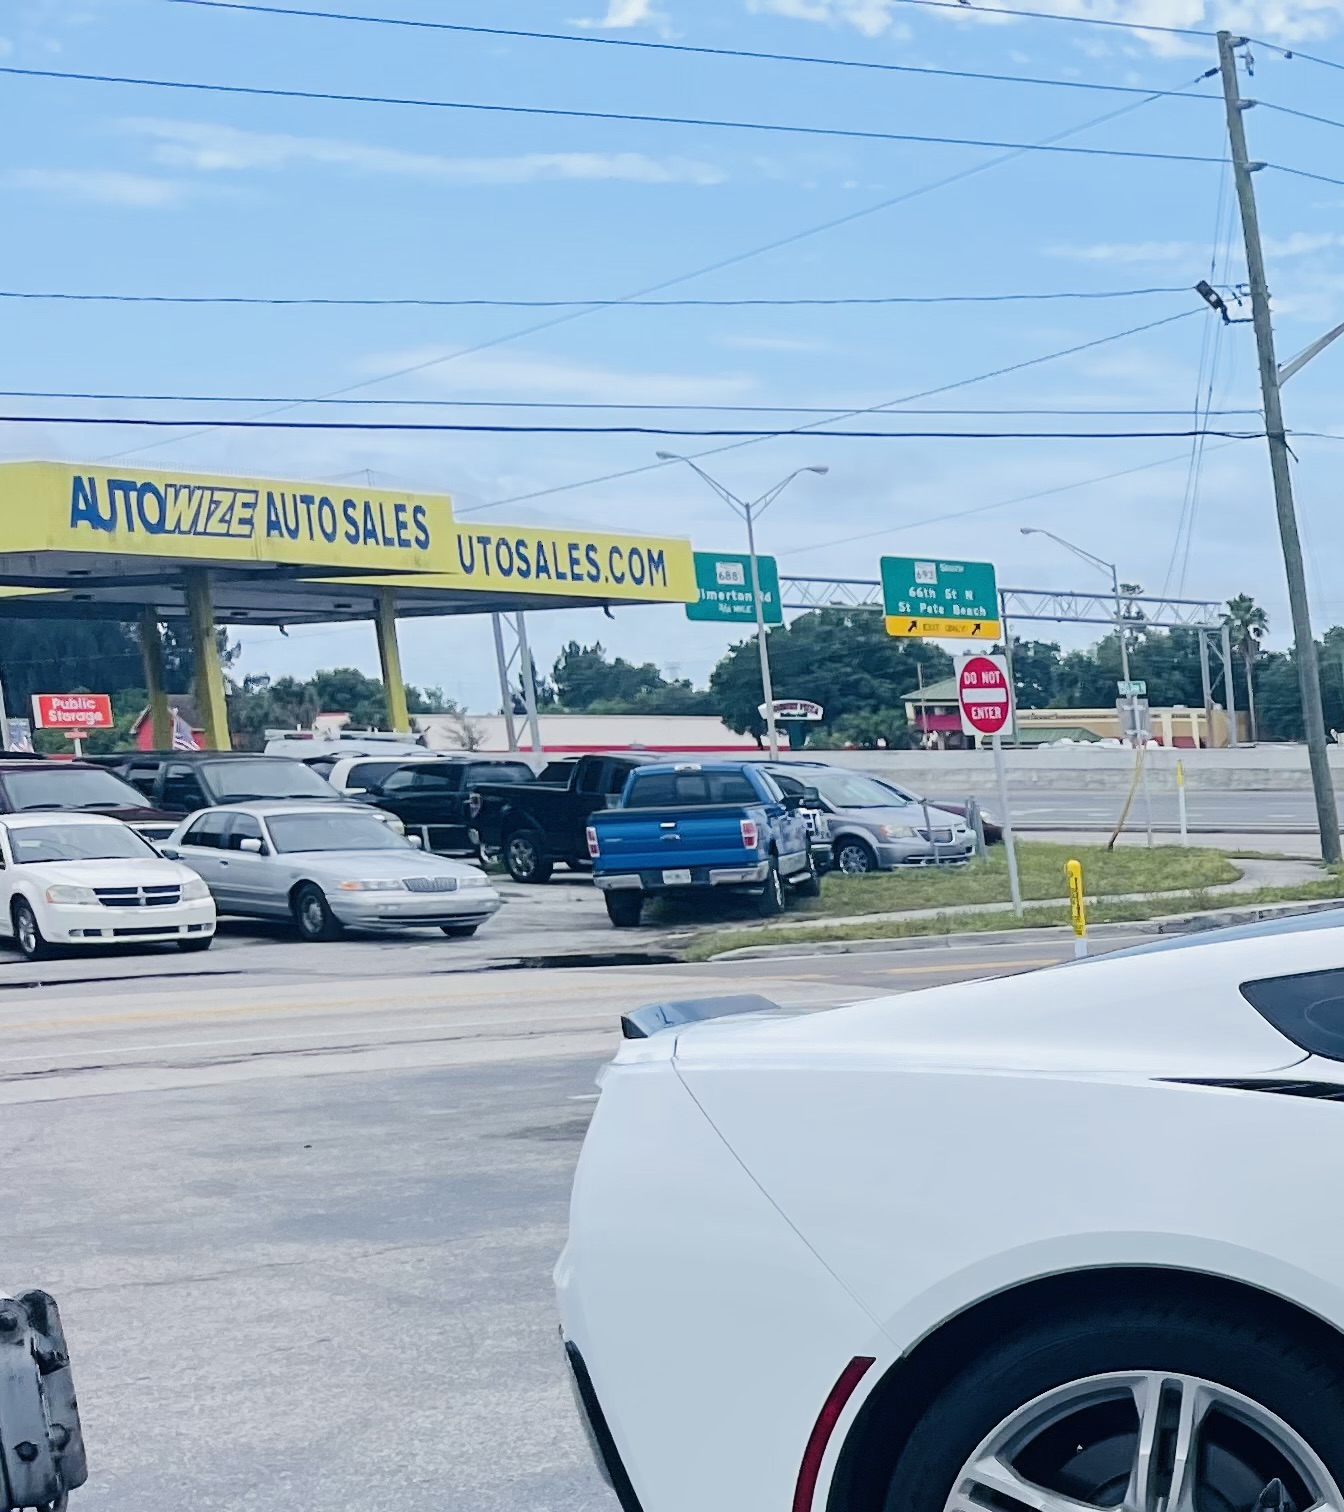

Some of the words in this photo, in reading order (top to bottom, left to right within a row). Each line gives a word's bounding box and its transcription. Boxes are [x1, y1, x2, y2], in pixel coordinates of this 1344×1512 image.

[70, 475, 259, 540] AUTOWIZE
[266, 490, 337, 543] AUTO
[342, 497, 430, 551] SALES
[718, 571, 739, 582] 688
[698, 588, 753, 602] lmerton
[908, 586, 936, 599] 66th
[898, 601, 911, 613] St
[919, 602, 945, 615] Pete
[952, 604, 987, 617] Beach
[963, 671, 978, 685] DO
[981, 670, 1000, 685] NOT
[52, 697, 97, 710] Public
[48, 709, 104, 726] Storage
[971, 706, 1002, 720] ENTER
